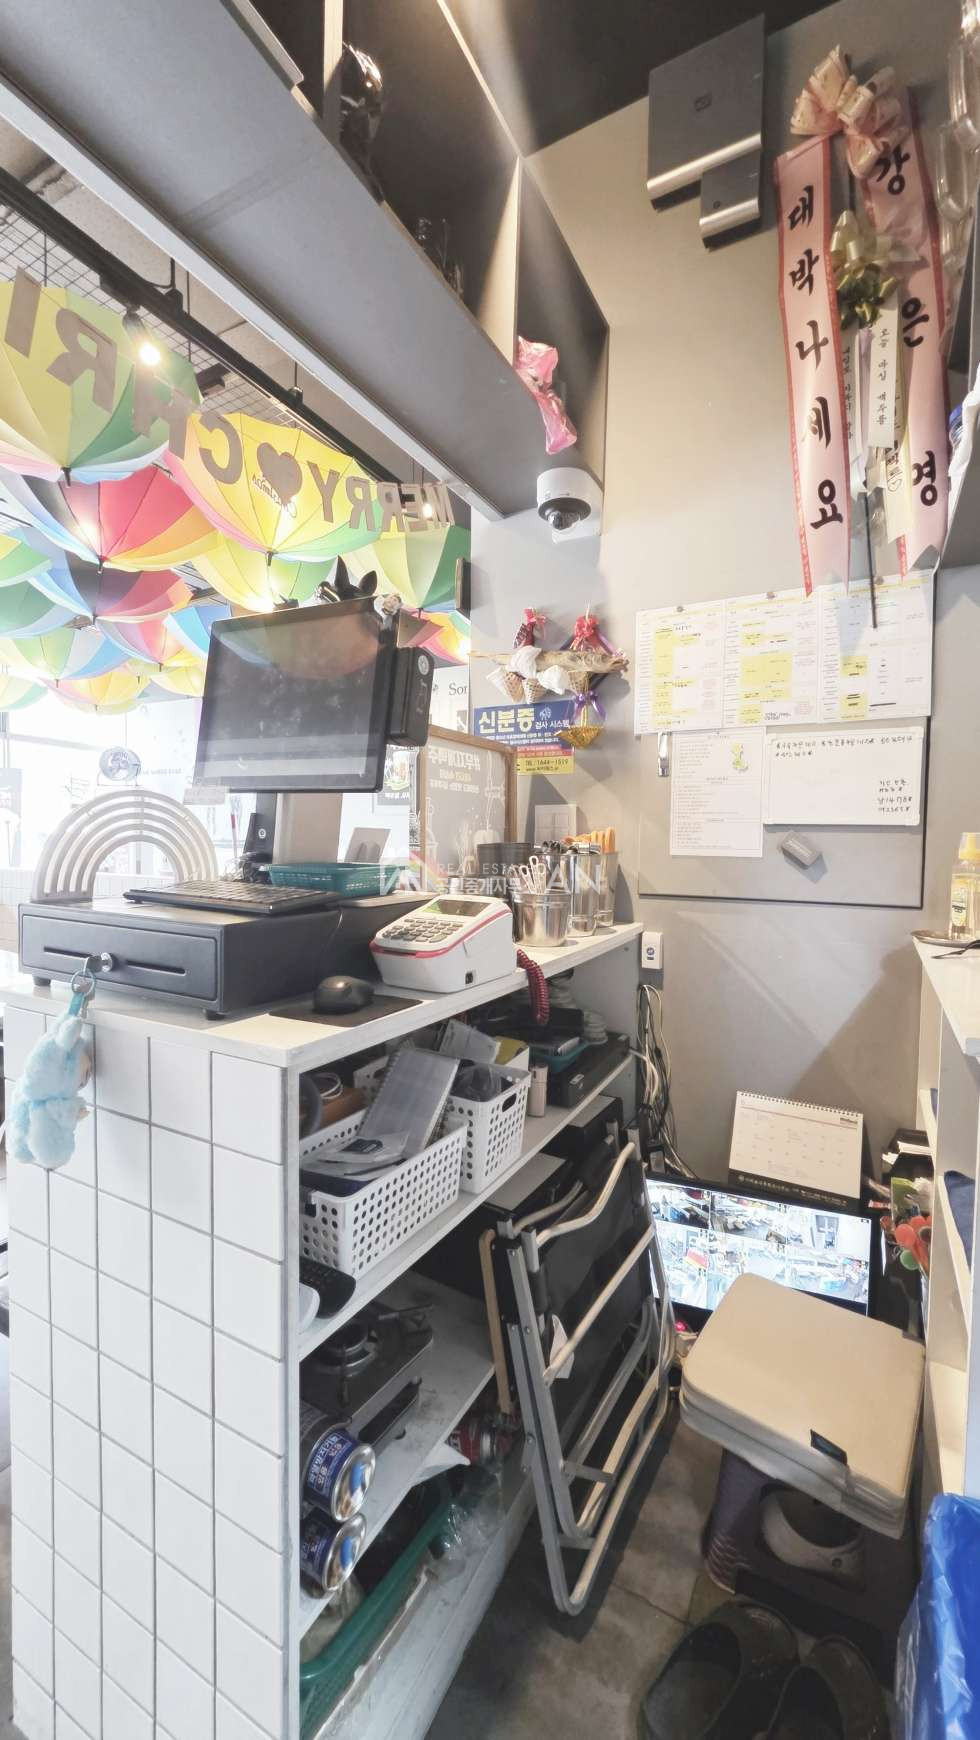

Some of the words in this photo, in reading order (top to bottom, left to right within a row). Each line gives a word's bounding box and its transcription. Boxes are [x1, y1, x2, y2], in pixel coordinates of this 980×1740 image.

[788, 185, 843, 529] 대박나세요
[478, 707, 535, 734] 신분증
[535, 721, 548, 730] 검사
[549, 719, 571, 729] 시스템
